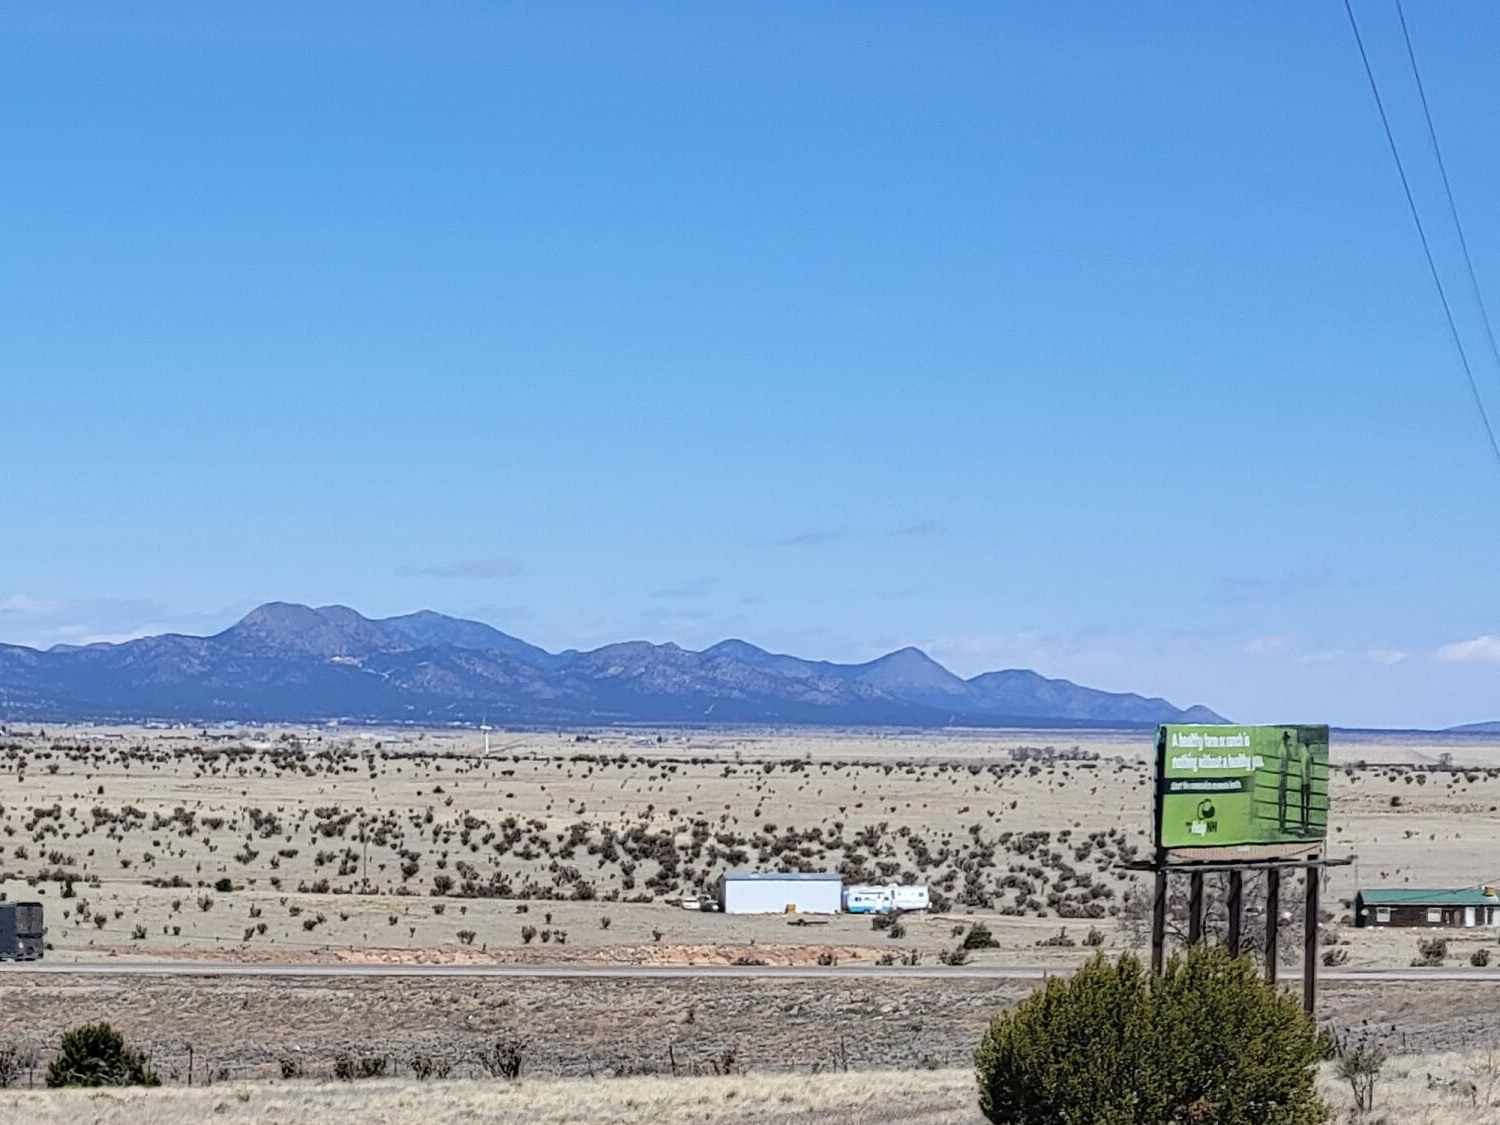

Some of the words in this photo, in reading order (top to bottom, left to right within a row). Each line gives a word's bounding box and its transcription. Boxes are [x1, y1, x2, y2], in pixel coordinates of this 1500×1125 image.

[1172, 732, 1178, 747] A
[1178, 732, 1203, 751] healthy
[1243, 731, 1250, 747] is
[1172, 753, 1198, 772] nothing
[1198, 753, 1222, 768] without
[1228, 753, 1251, 771] healthy
